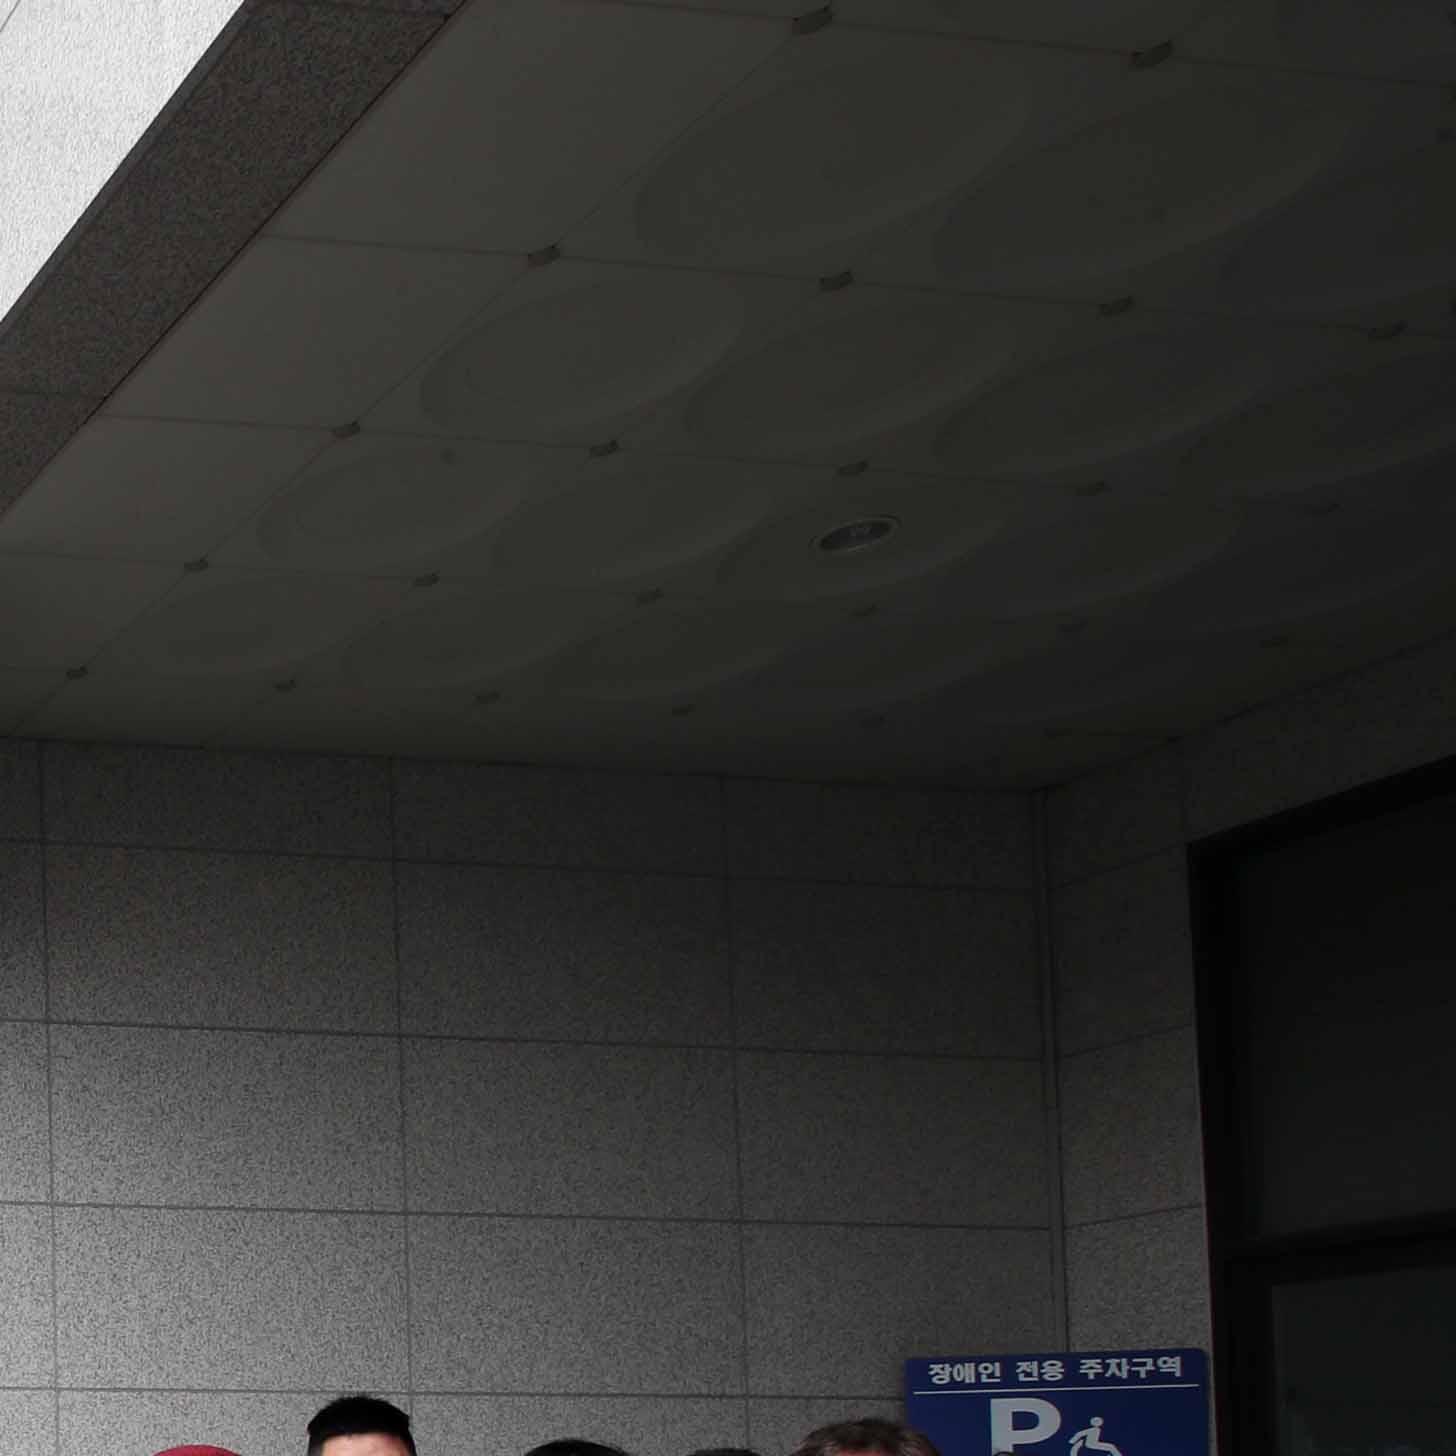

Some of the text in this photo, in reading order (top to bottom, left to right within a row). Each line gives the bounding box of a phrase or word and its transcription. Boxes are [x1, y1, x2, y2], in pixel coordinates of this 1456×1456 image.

[928, 1356, 1182, 1385] 장애인 전용 주차구역
[990, 1397, 1062, 1456] P
